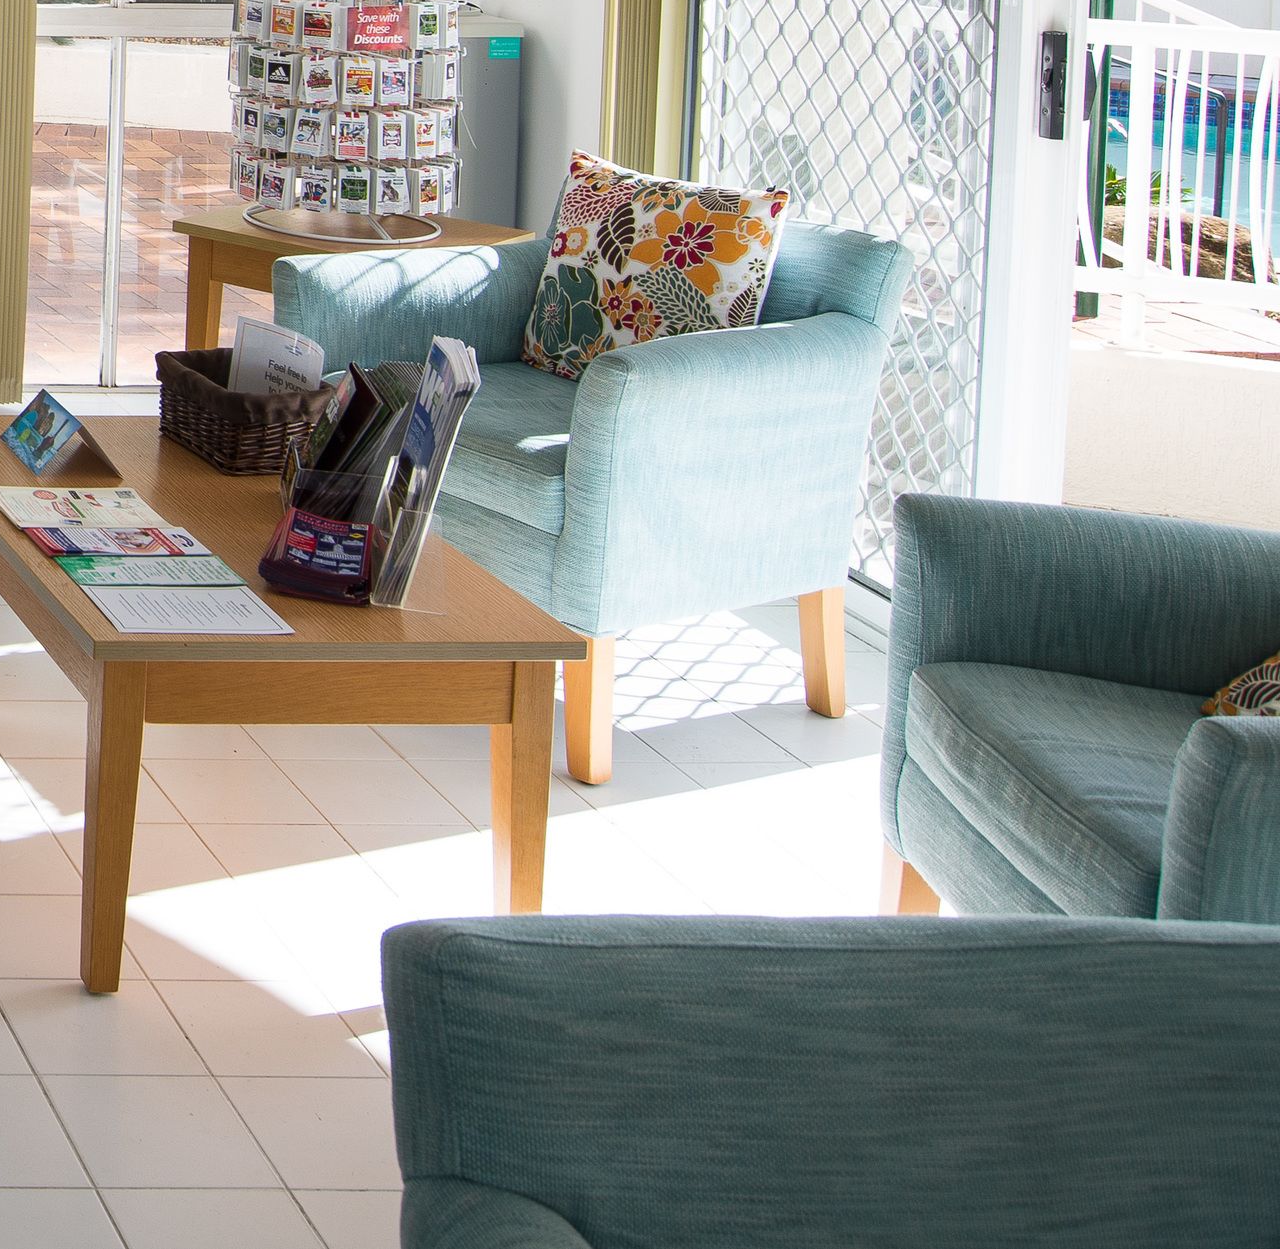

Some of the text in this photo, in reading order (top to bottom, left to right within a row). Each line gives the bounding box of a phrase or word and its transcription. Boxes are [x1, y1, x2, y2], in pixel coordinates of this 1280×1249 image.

[357, 12, 400, 23] Save with
[366, 24, 391, 34] these
[354, 34, 403, 45] Discounts
[268, 359, 287, 373] Feel
[287, 366, 301, 380] free
[264, 371, 284, 387] Help
